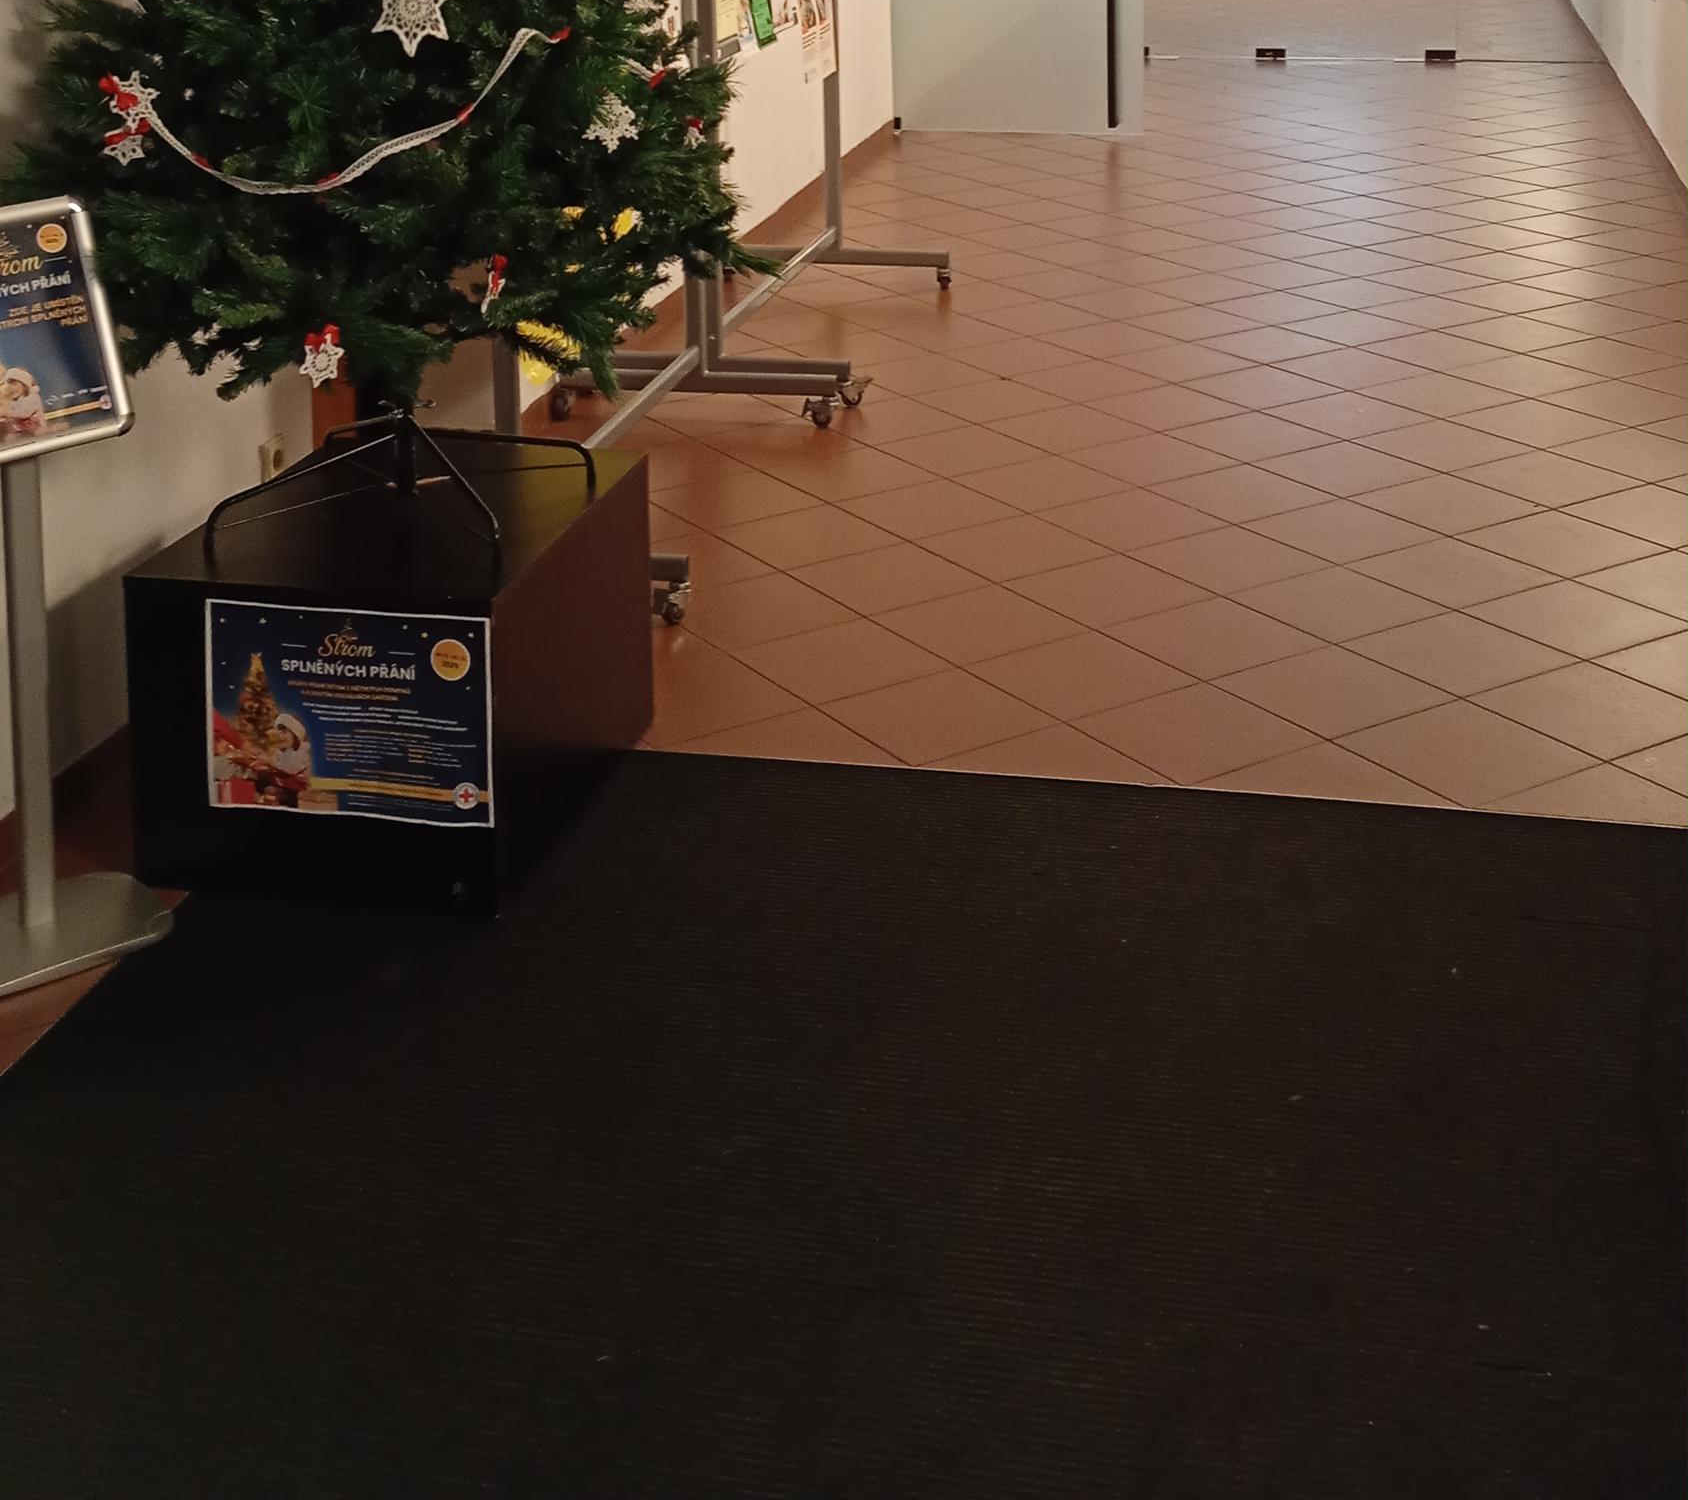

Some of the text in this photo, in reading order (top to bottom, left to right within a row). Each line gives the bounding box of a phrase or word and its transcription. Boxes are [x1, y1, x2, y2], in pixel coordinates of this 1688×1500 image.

[31, 270, 72, 291] PŘÁNÍ
[318, 633, 376, 659] Strom
[281, 658, 416, 681] SPLNĚNÝCH PŘÁNÍ
